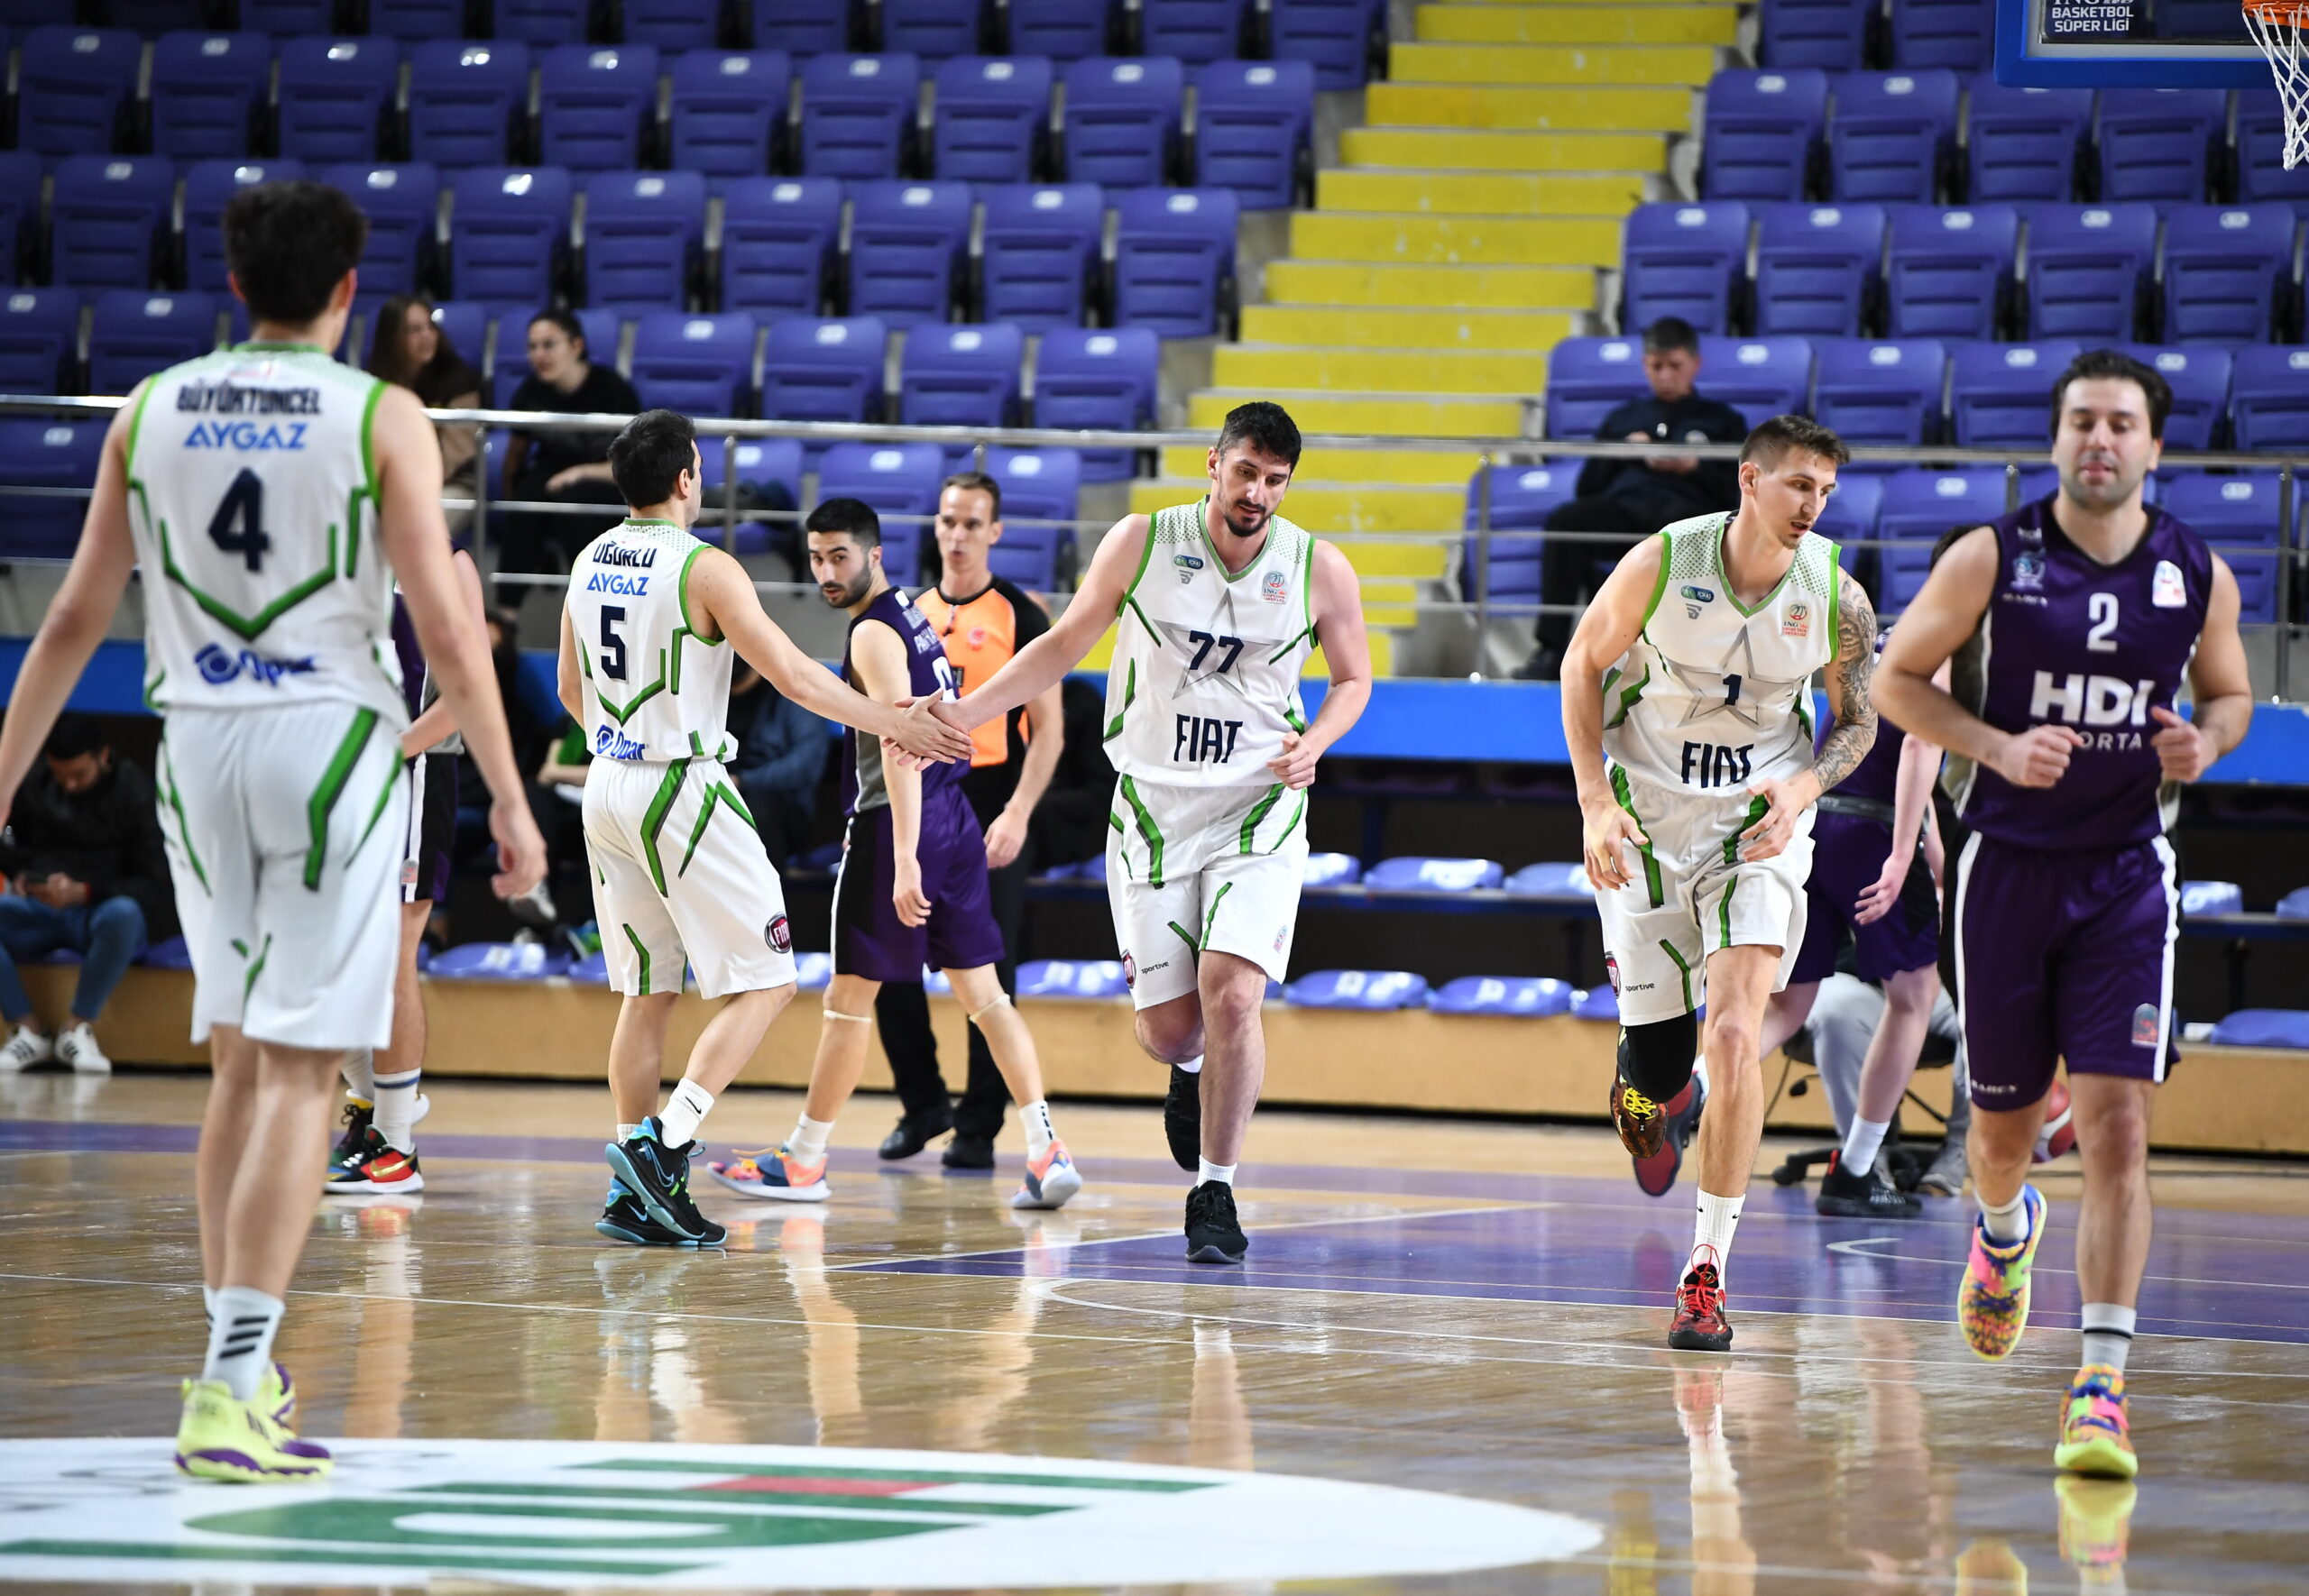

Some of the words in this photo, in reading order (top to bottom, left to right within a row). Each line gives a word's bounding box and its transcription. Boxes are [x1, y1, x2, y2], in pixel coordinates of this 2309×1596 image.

[2052, 6, 2134, 18] BASKETBOL
[2055, 19, 2101, 32] SÜPER
[2103, 18, 2130, 32] LİGİ
[184, 422, 308, 450] AYGAZ
[207, 466, 269, 573] 4
[587, 572, 649, 596] AYGAZ
[2087, 592, 2119, 652] 2
[601, 605, 626, 681] 5
[1189, 630, 1245, 673] 77
[1722, 674, 1743, 705] 1
[2029, 670, 2156, 727] HDI
[1173, 713, 1243, 763] FIAT
[1681, 740, 1754, 788] FIAT
[1141, 961, 1169, 975] sportive
[1625, 983, 1655, 992] sportive
